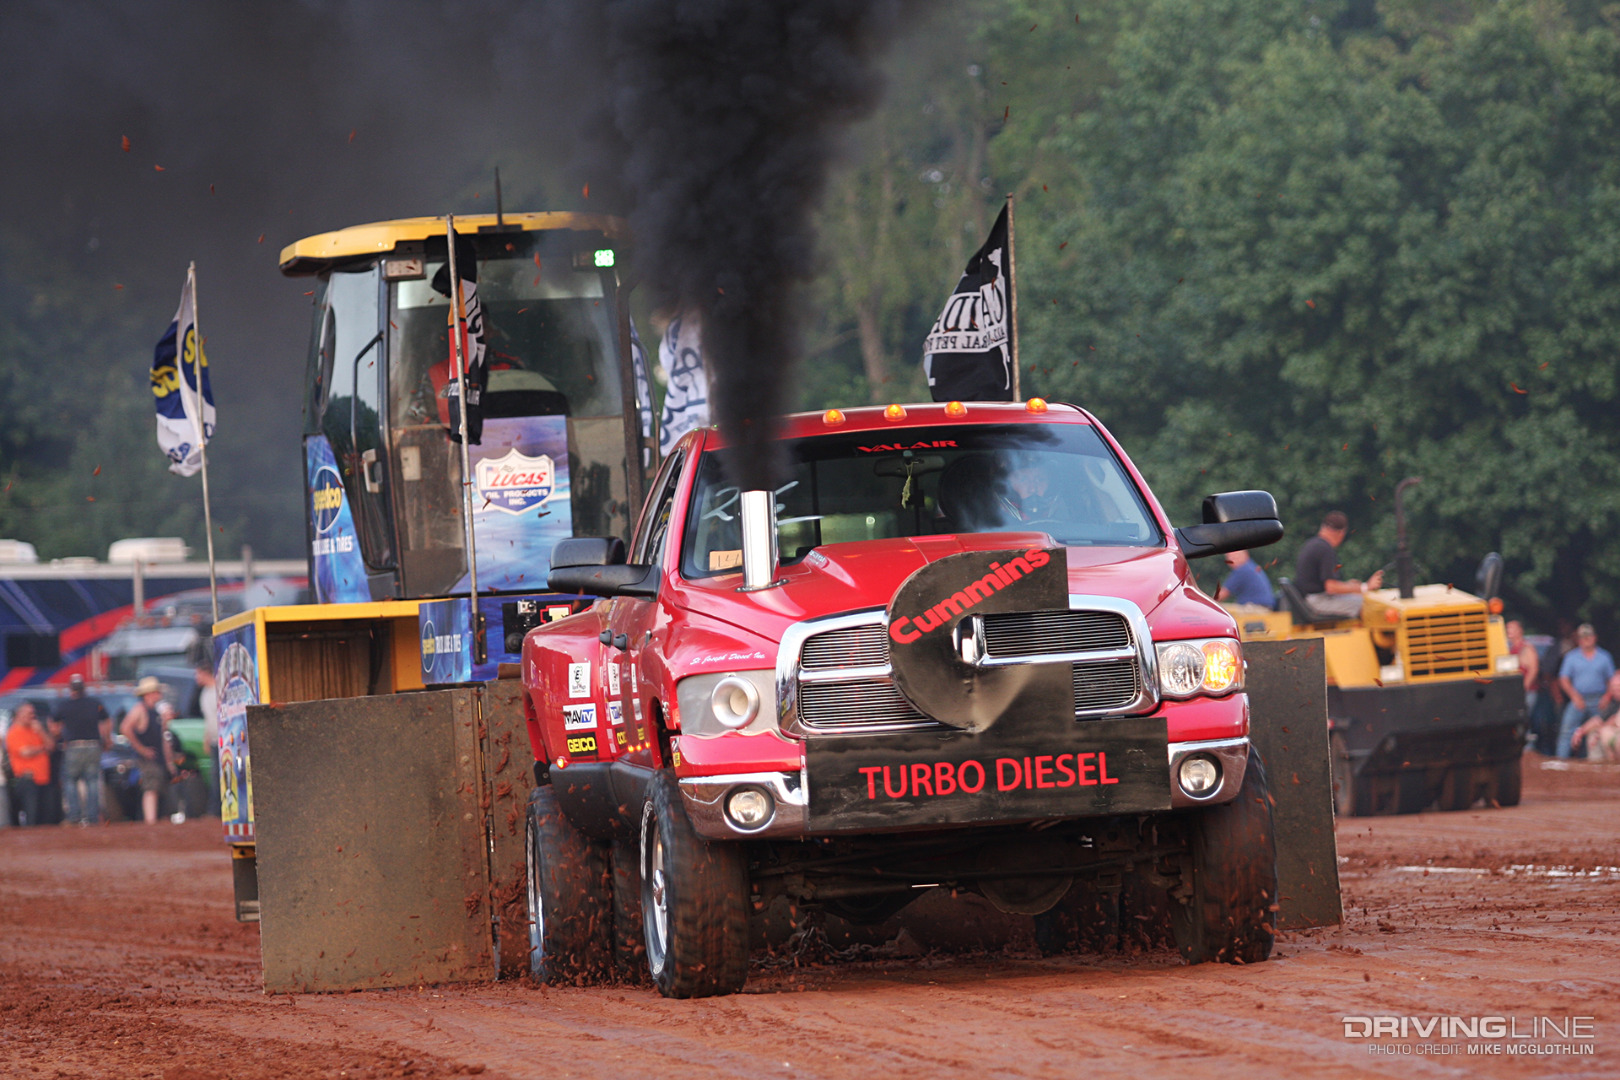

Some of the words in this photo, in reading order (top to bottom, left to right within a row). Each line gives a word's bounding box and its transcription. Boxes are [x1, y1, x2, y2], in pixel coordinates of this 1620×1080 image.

[857, 440, 959, 453] VALAIR
[490, 471, 547, 487] LUCAS
[889, 547, 1051, 645] Cummins
[566, 736, 596, 753] GEICO
[858, 759, 986, 800] TURBO
[995, 752, 1119, 792] DIESEL
